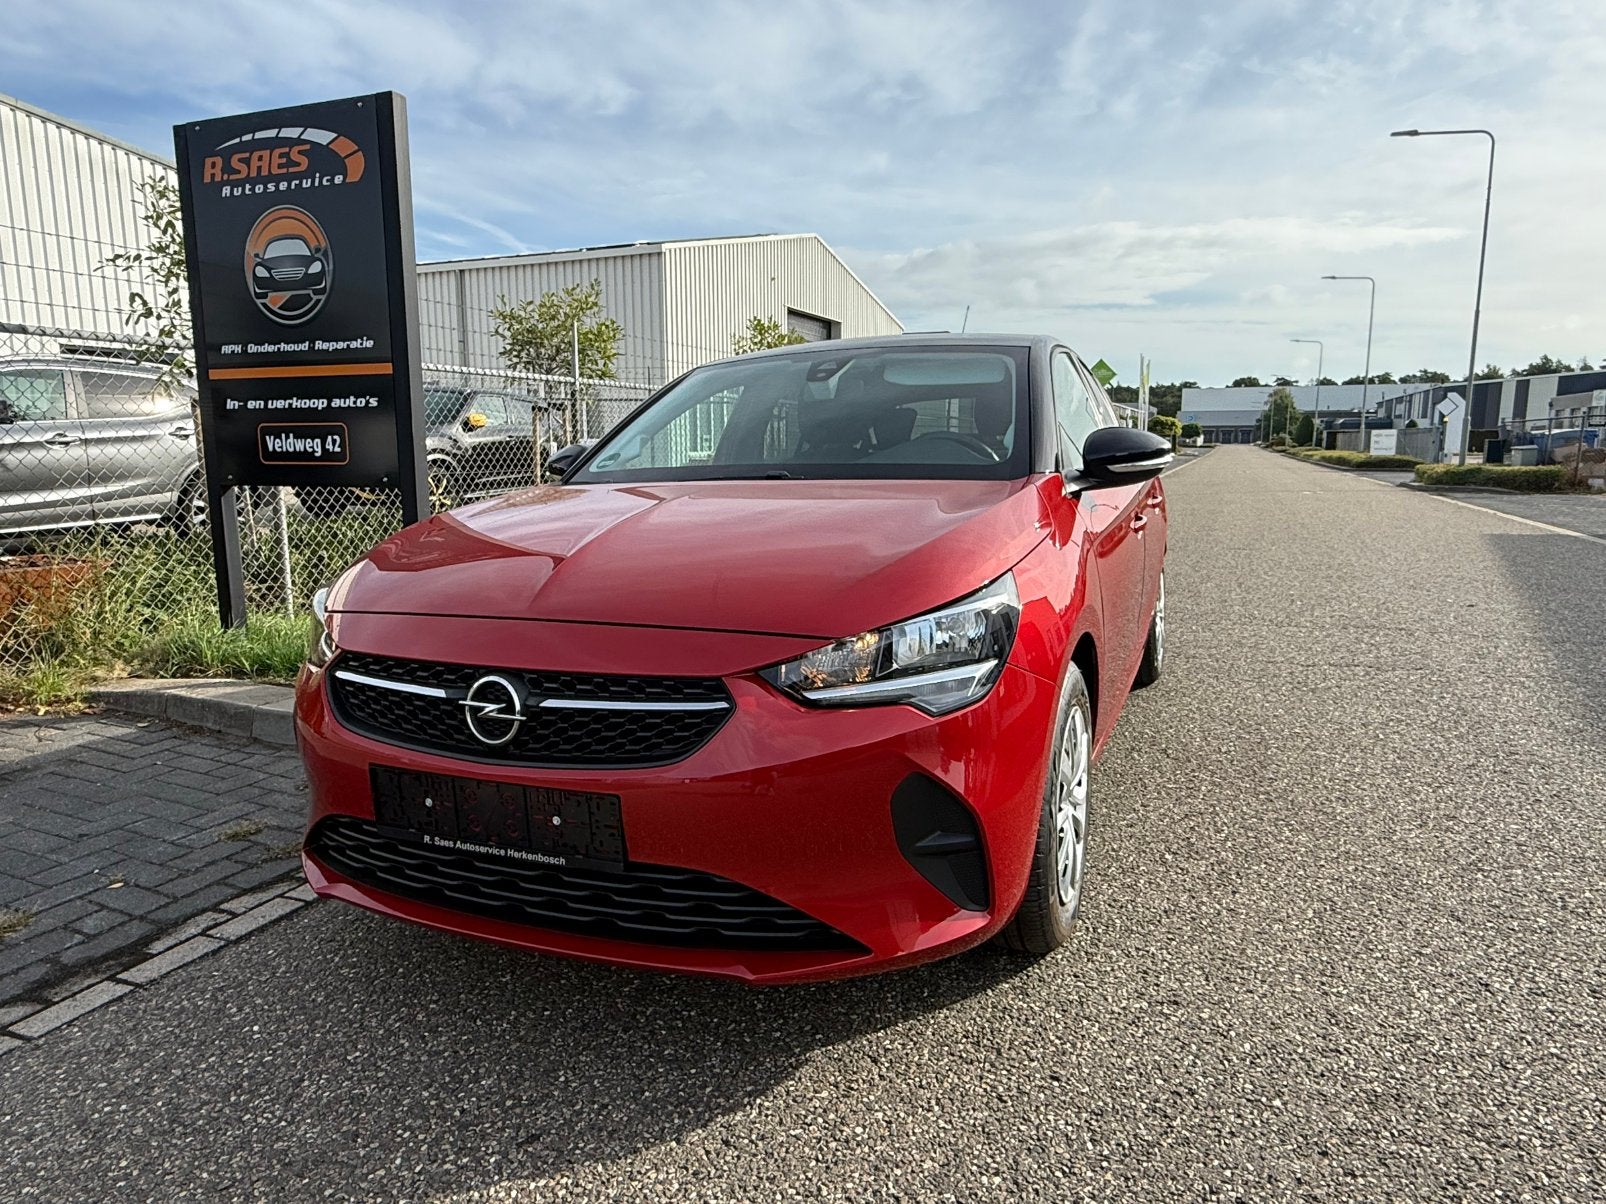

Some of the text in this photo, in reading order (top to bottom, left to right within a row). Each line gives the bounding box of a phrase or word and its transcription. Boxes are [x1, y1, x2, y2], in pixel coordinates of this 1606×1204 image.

[203, 144, 311, 183] R.SAES
[221, 173, 344, 198] Autoservice
[247, 341, 309, 354] Onderhoud
[314, 337, 374, 351] Reparatie
[226, 395, 378, 411] In- en verkoop auto's
[265, 433, 342, 457] Veldweg 42
[423, 835, 566, 866] R. Saes Autoservice Herkenbosch
